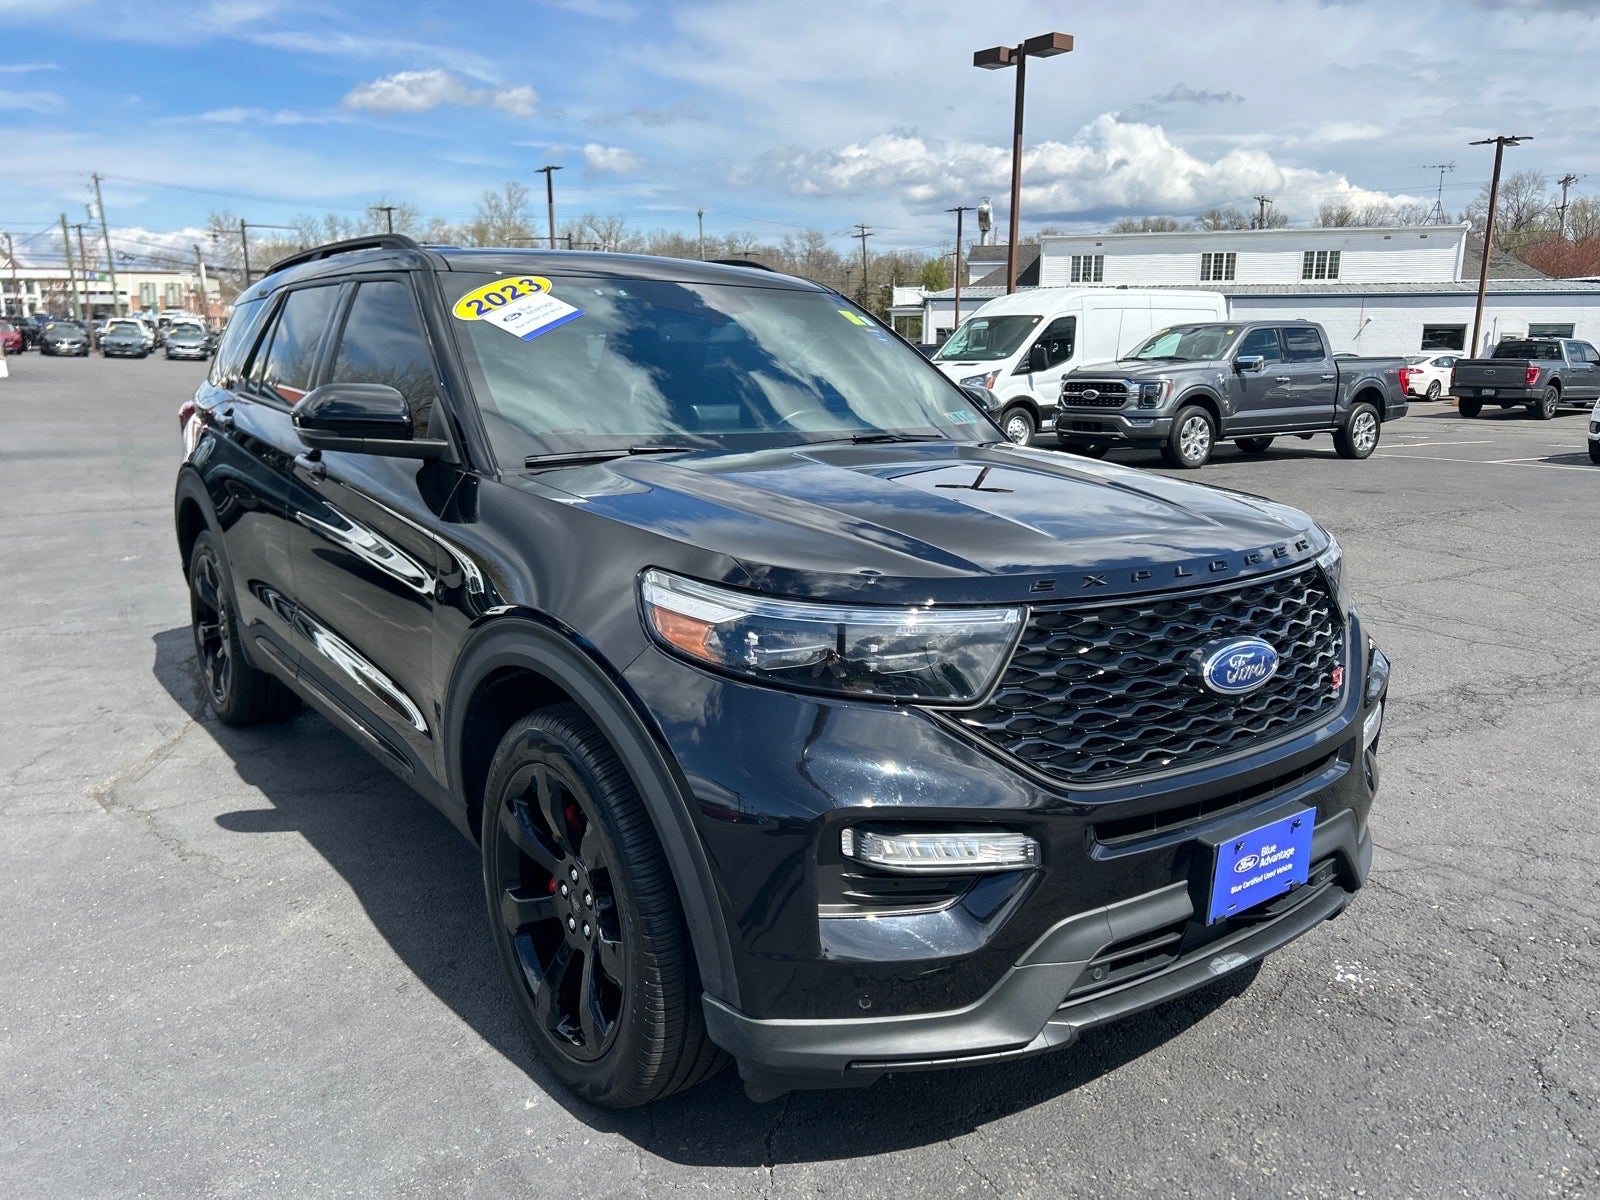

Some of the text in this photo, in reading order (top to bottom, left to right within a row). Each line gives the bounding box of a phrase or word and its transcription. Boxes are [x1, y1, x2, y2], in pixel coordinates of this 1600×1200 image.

[466, 279, 542, 316] 2023
[1028, 538, 1311, 593] EXPLORER
[1226, 652, 1266, 684] Ford
[1259, 847, 1295, 868] Advantage
[1260, 844, 1277, 857] Blue
[1230, 863, 1293, 895] Blue Certified Used Vehicle
